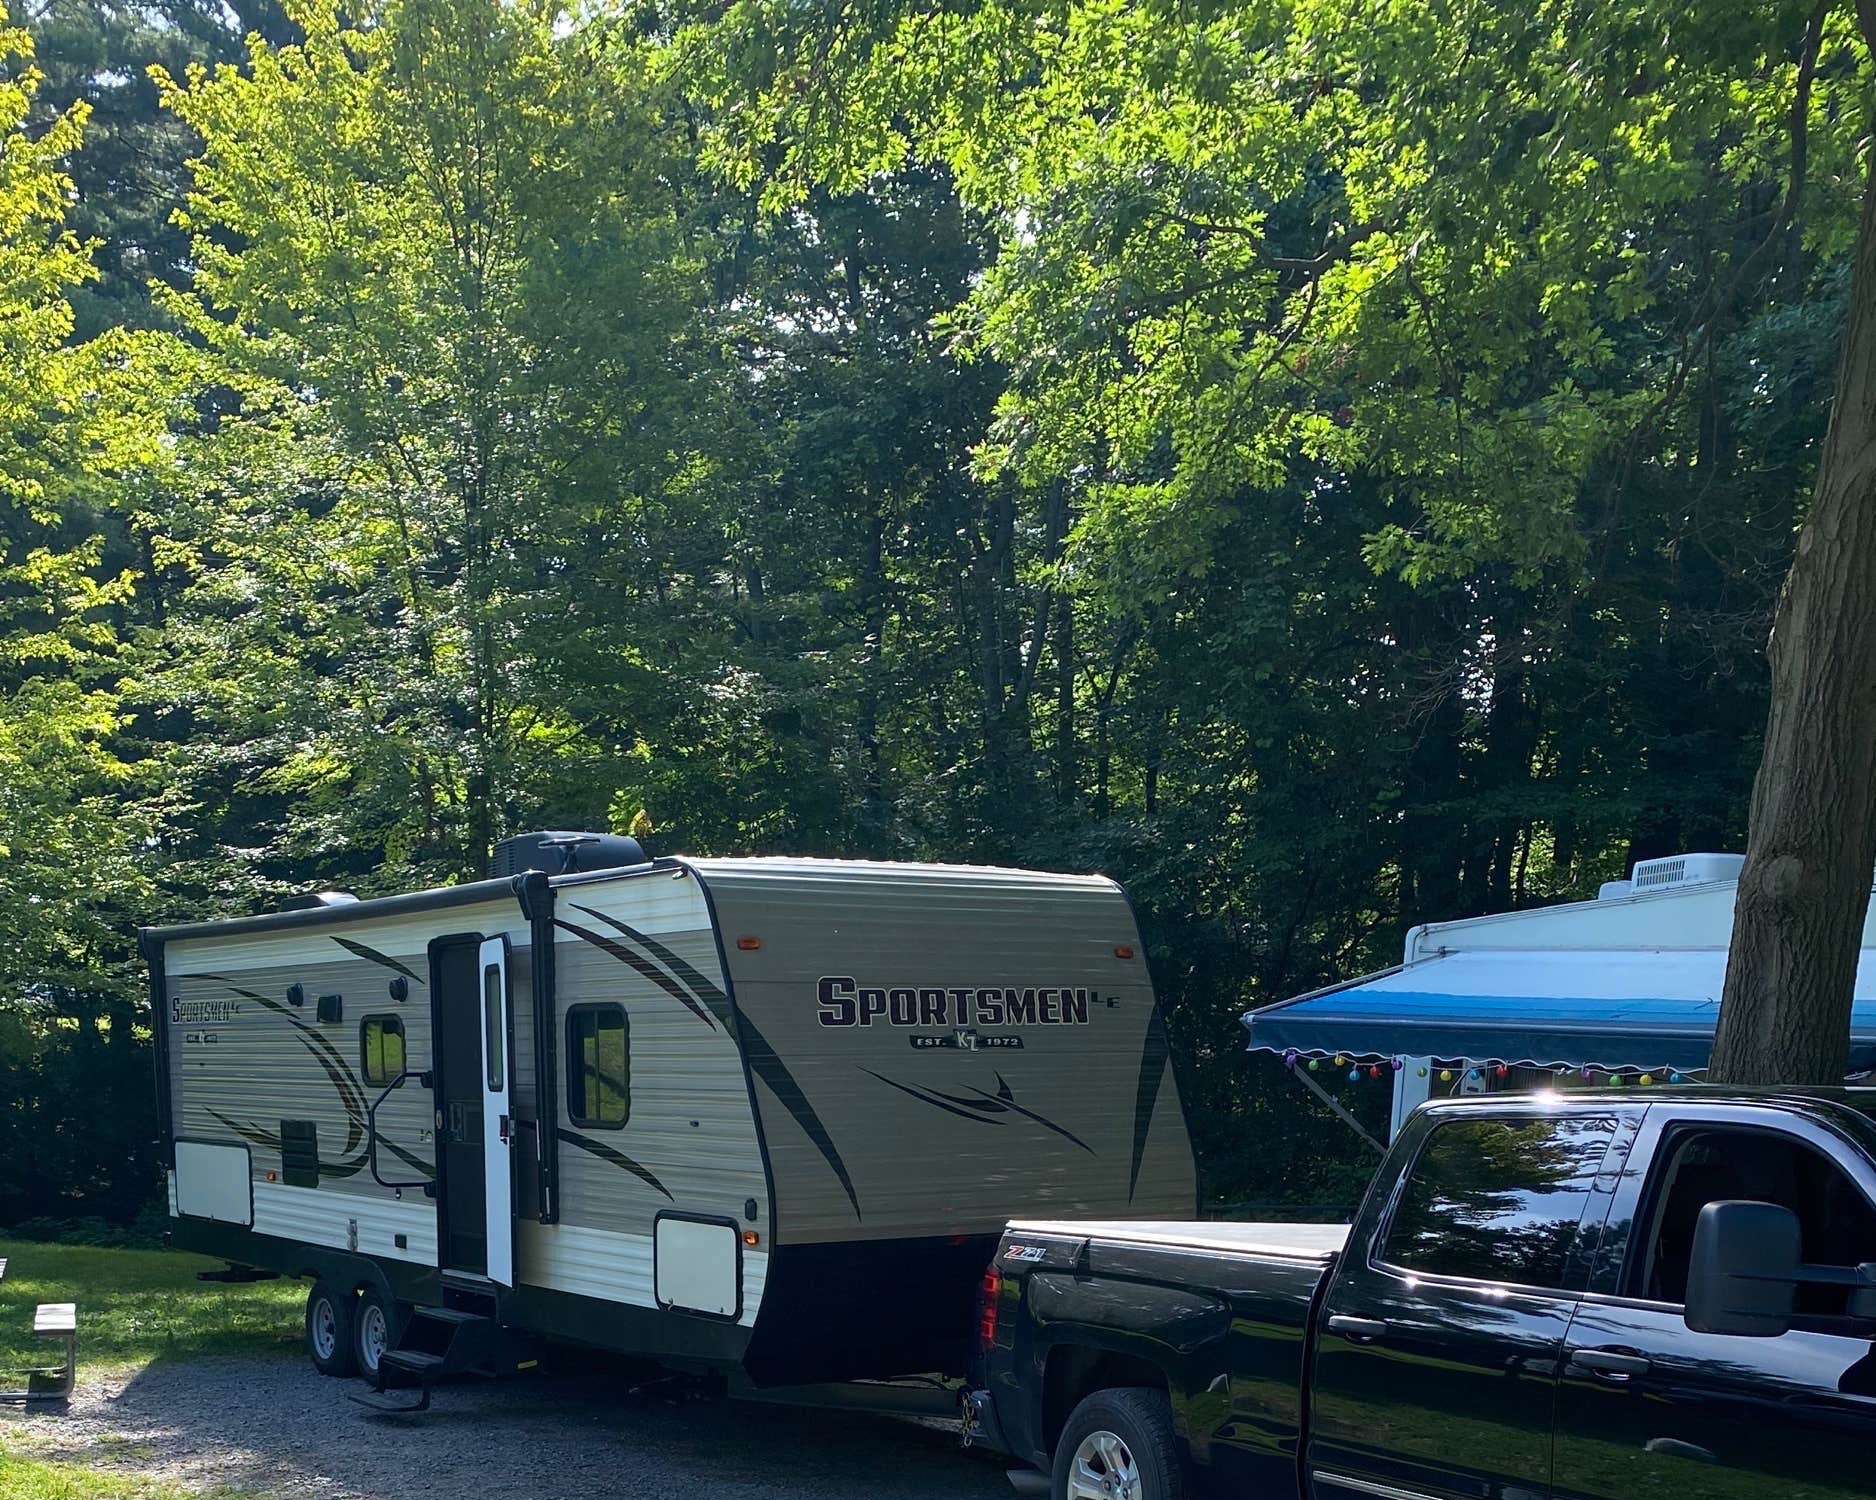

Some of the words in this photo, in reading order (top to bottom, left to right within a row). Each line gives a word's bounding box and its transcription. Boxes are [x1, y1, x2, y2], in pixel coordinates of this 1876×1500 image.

[817, 976, 1089, 1027] SPORTSMEN
[1091, 992, 1120, 1009] LE
[986, 1038, 1019, 1046] 1972
[1003, 1245, 1047, 1262] Z71
